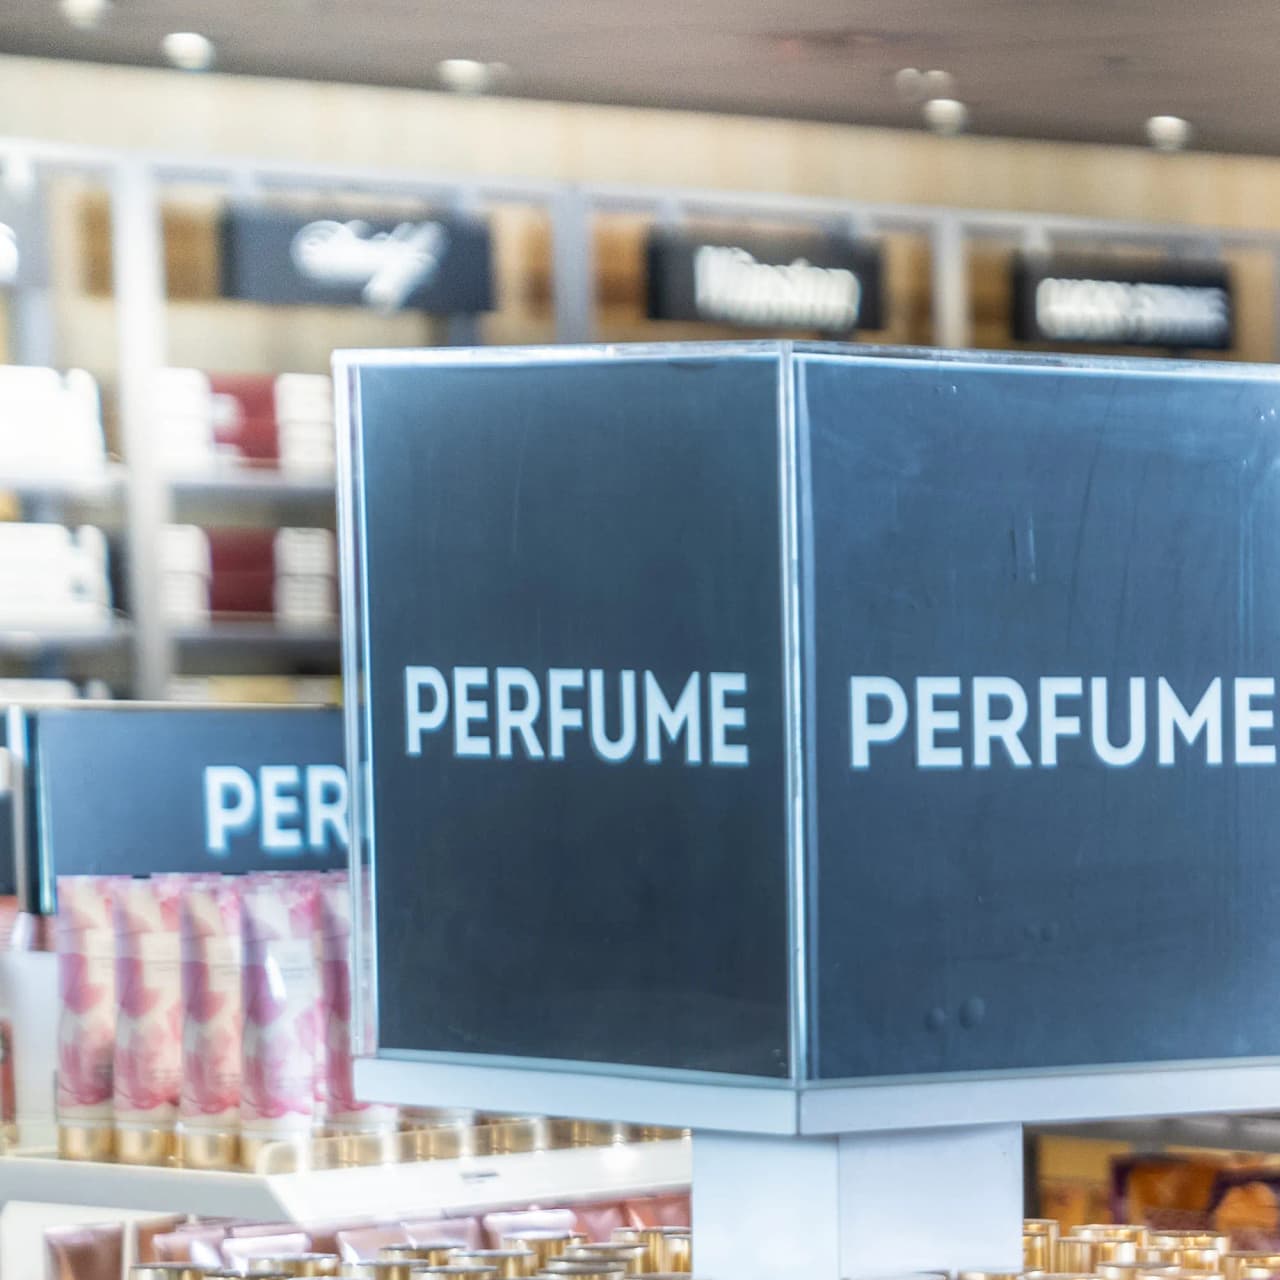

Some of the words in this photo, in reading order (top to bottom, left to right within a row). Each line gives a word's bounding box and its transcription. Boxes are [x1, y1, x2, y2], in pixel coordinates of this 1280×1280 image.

[404, 665, 749, 764] PERFUME
[850, 675, 1277, 768] PERFUME
[205, 765, 347, 851] PER
